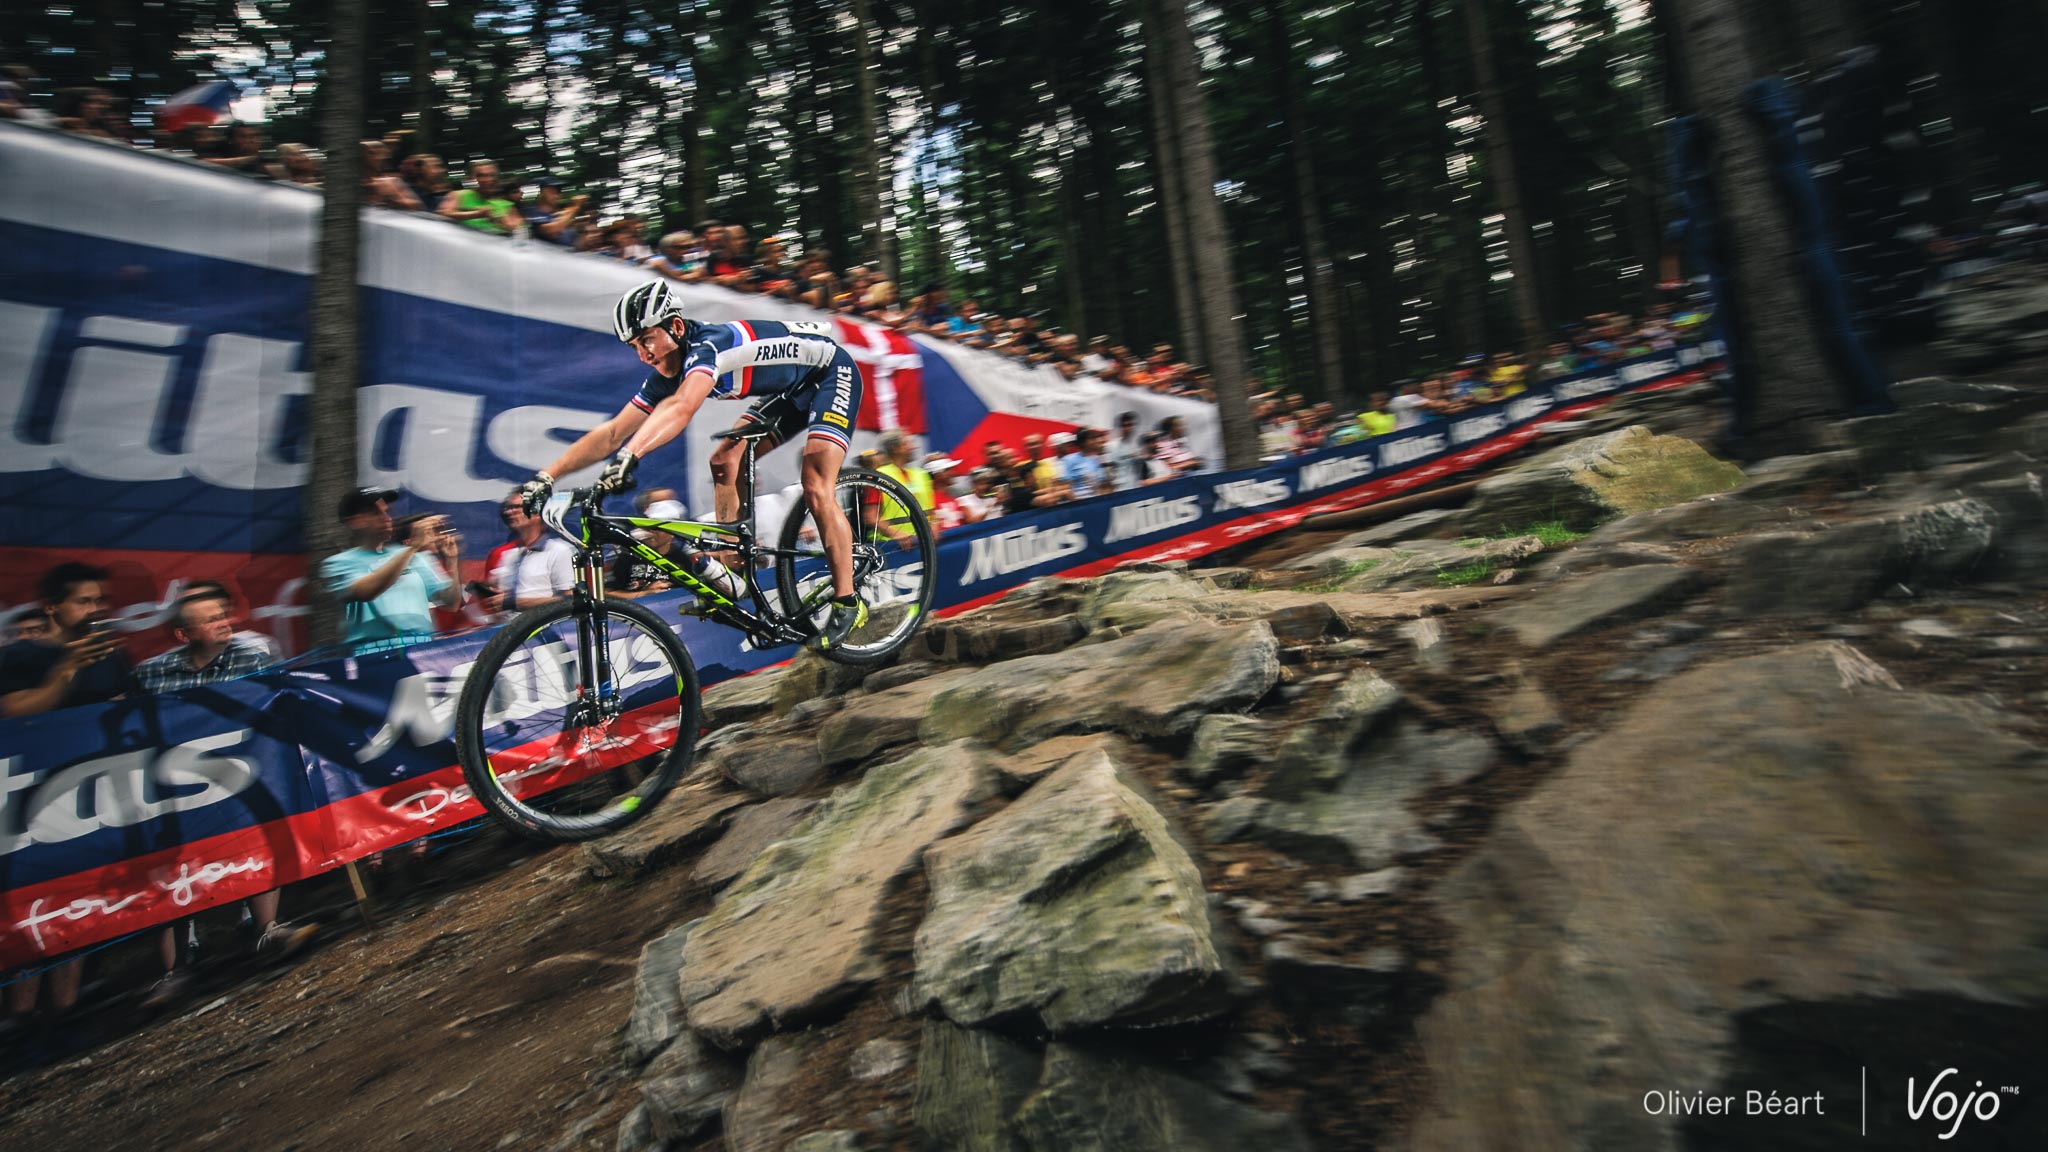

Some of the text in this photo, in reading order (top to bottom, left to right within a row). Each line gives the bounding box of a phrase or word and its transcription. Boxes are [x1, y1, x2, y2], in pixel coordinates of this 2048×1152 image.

[754, 341, 800, 361] FRANCE
[0, 300, 614, 503] itas
[831, 365, 852, 417] FRANCE
[630, 544, 735, 606] SCOTT
[0, 728, 259, 856] tas
[495, 797, 519, 819] COBRA
[12, 863, 266, 950] for you
